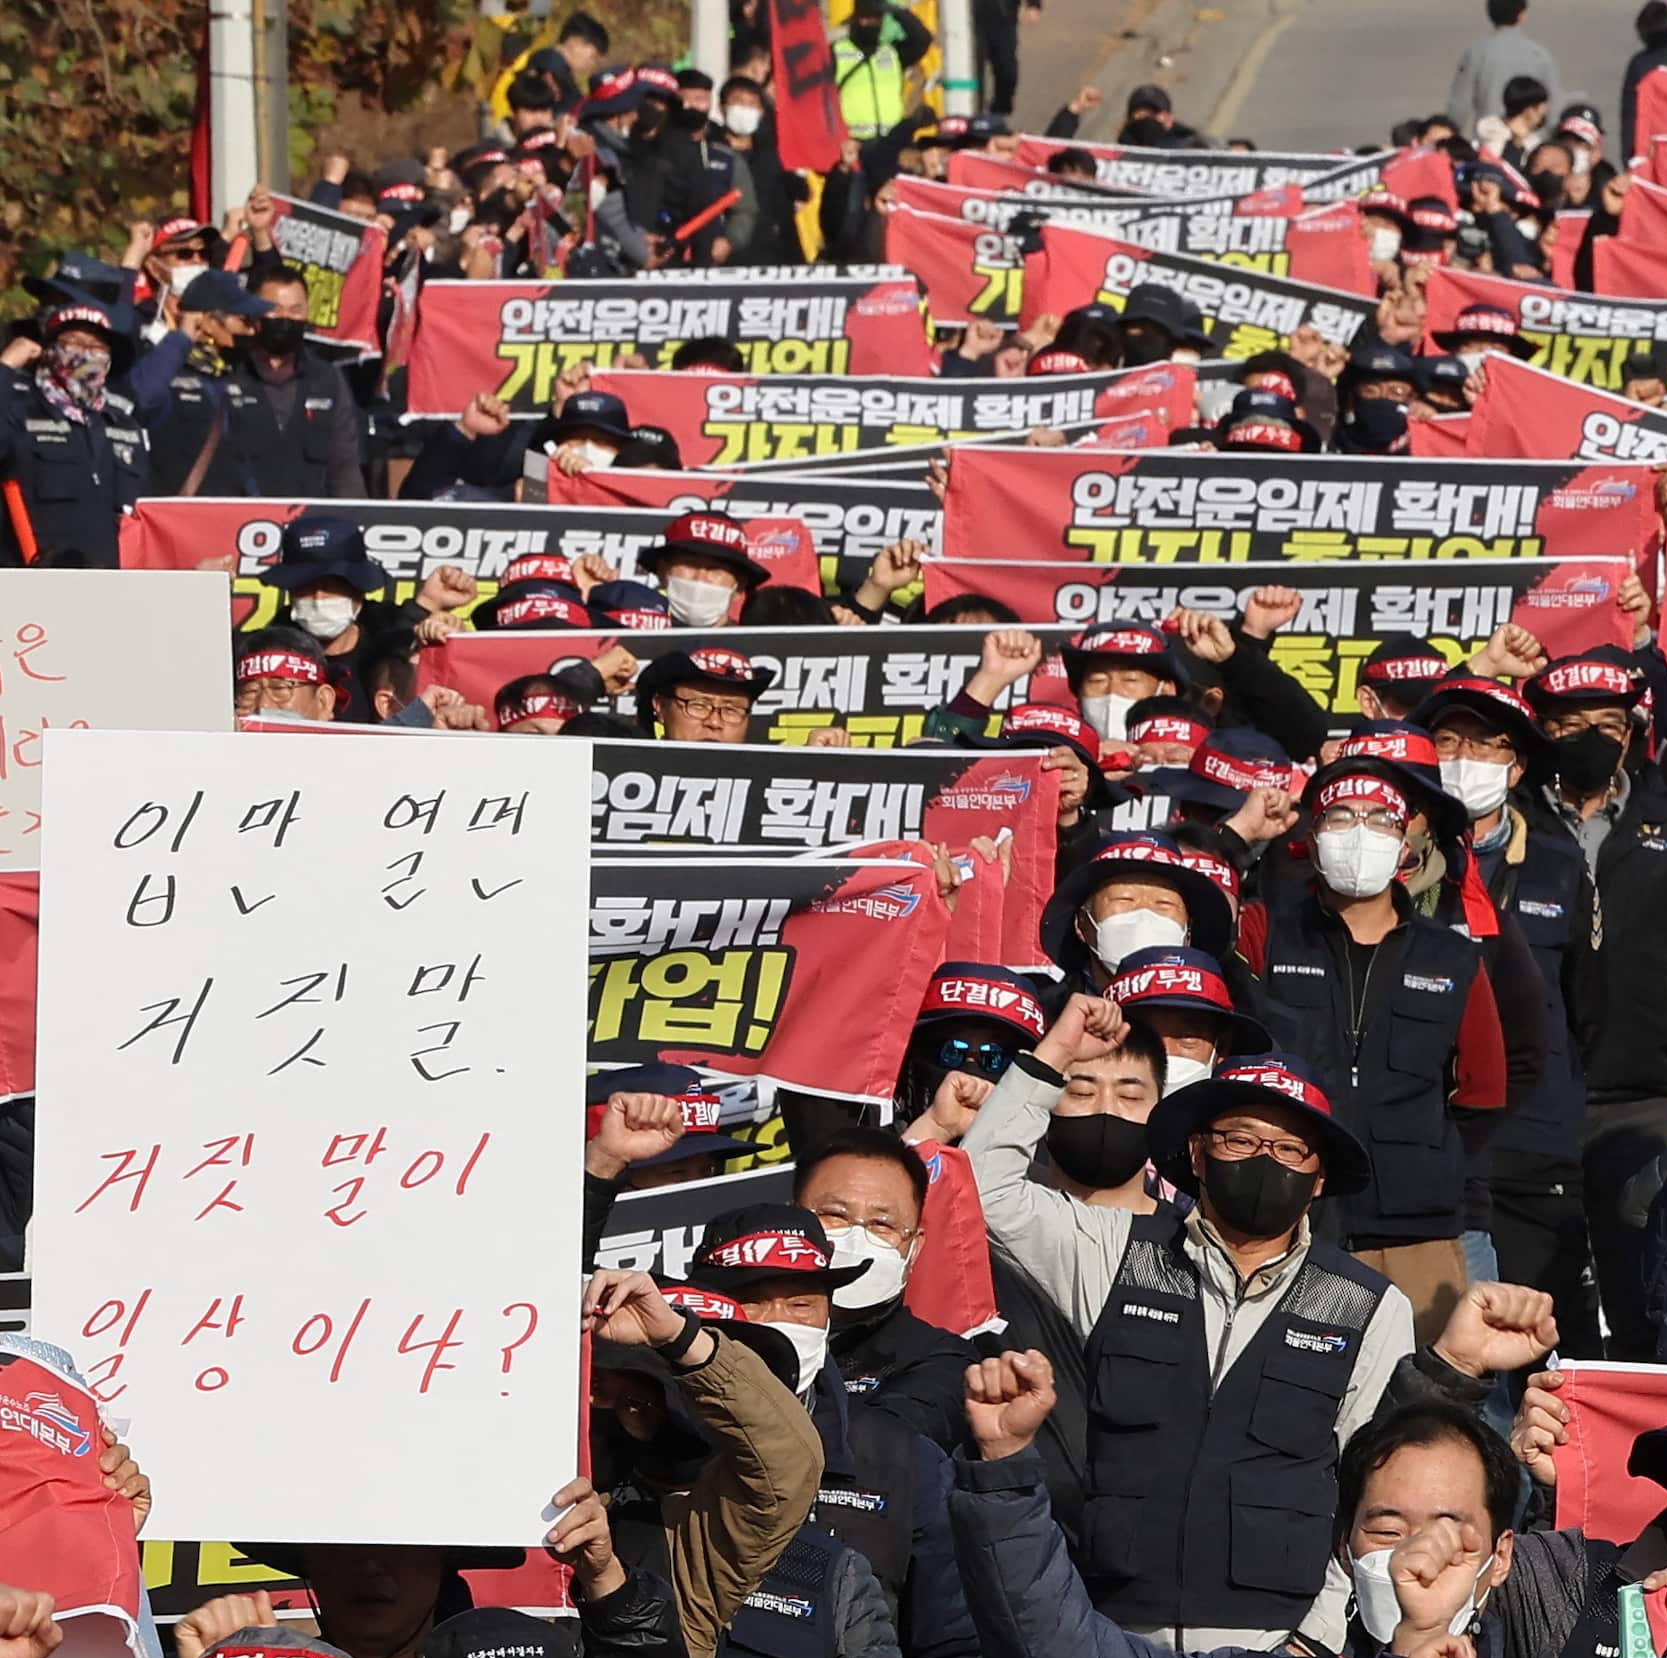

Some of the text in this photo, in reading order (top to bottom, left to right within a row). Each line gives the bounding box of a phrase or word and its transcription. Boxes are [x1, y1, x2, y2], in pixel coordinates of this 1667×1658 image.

[1188, 214, 1286, 254] 확대!
[1105, 252, 1307, 334] 안전운임제
[500, 295, 847, 342] 안전운임제 확대!
[706, 383, 1095, 430] 안전운임제 확대!
[1072, 473, 1539, 541] 안전운임제 확대!
[1552, 492, 1622, 510] 화물연대본부
[1371, 584, 1511, 642] 확대!
[286, 658, 317, 680] 투쟁
[1386, 661, 1422, 680] 단결
[1548, 672, 1578, 690] 단결
[1152, 718, 1190, 740] 투쟁
[1368, 739, 1409, 758] 투쟁
[941, 790, 1018, 811] 화물연대본부
[1320, 783, 1355, 806] 단결
[762, 778, 920, 847] 확대!
[1103, 969, 1201, 999] 단결 투쟁
[117, 953, 505, 1082] 거짓말.
[940, 981, 1044, 1036] 단결 투쟁
[75, 1127, 492, 1227] 거짓말이
[81, 1288, 539, 1403] 일상이냐?
[1285, 1336, 1332, 1352] 화물연대본부
[818, 1495, 874, 1511] 화물연대본부
